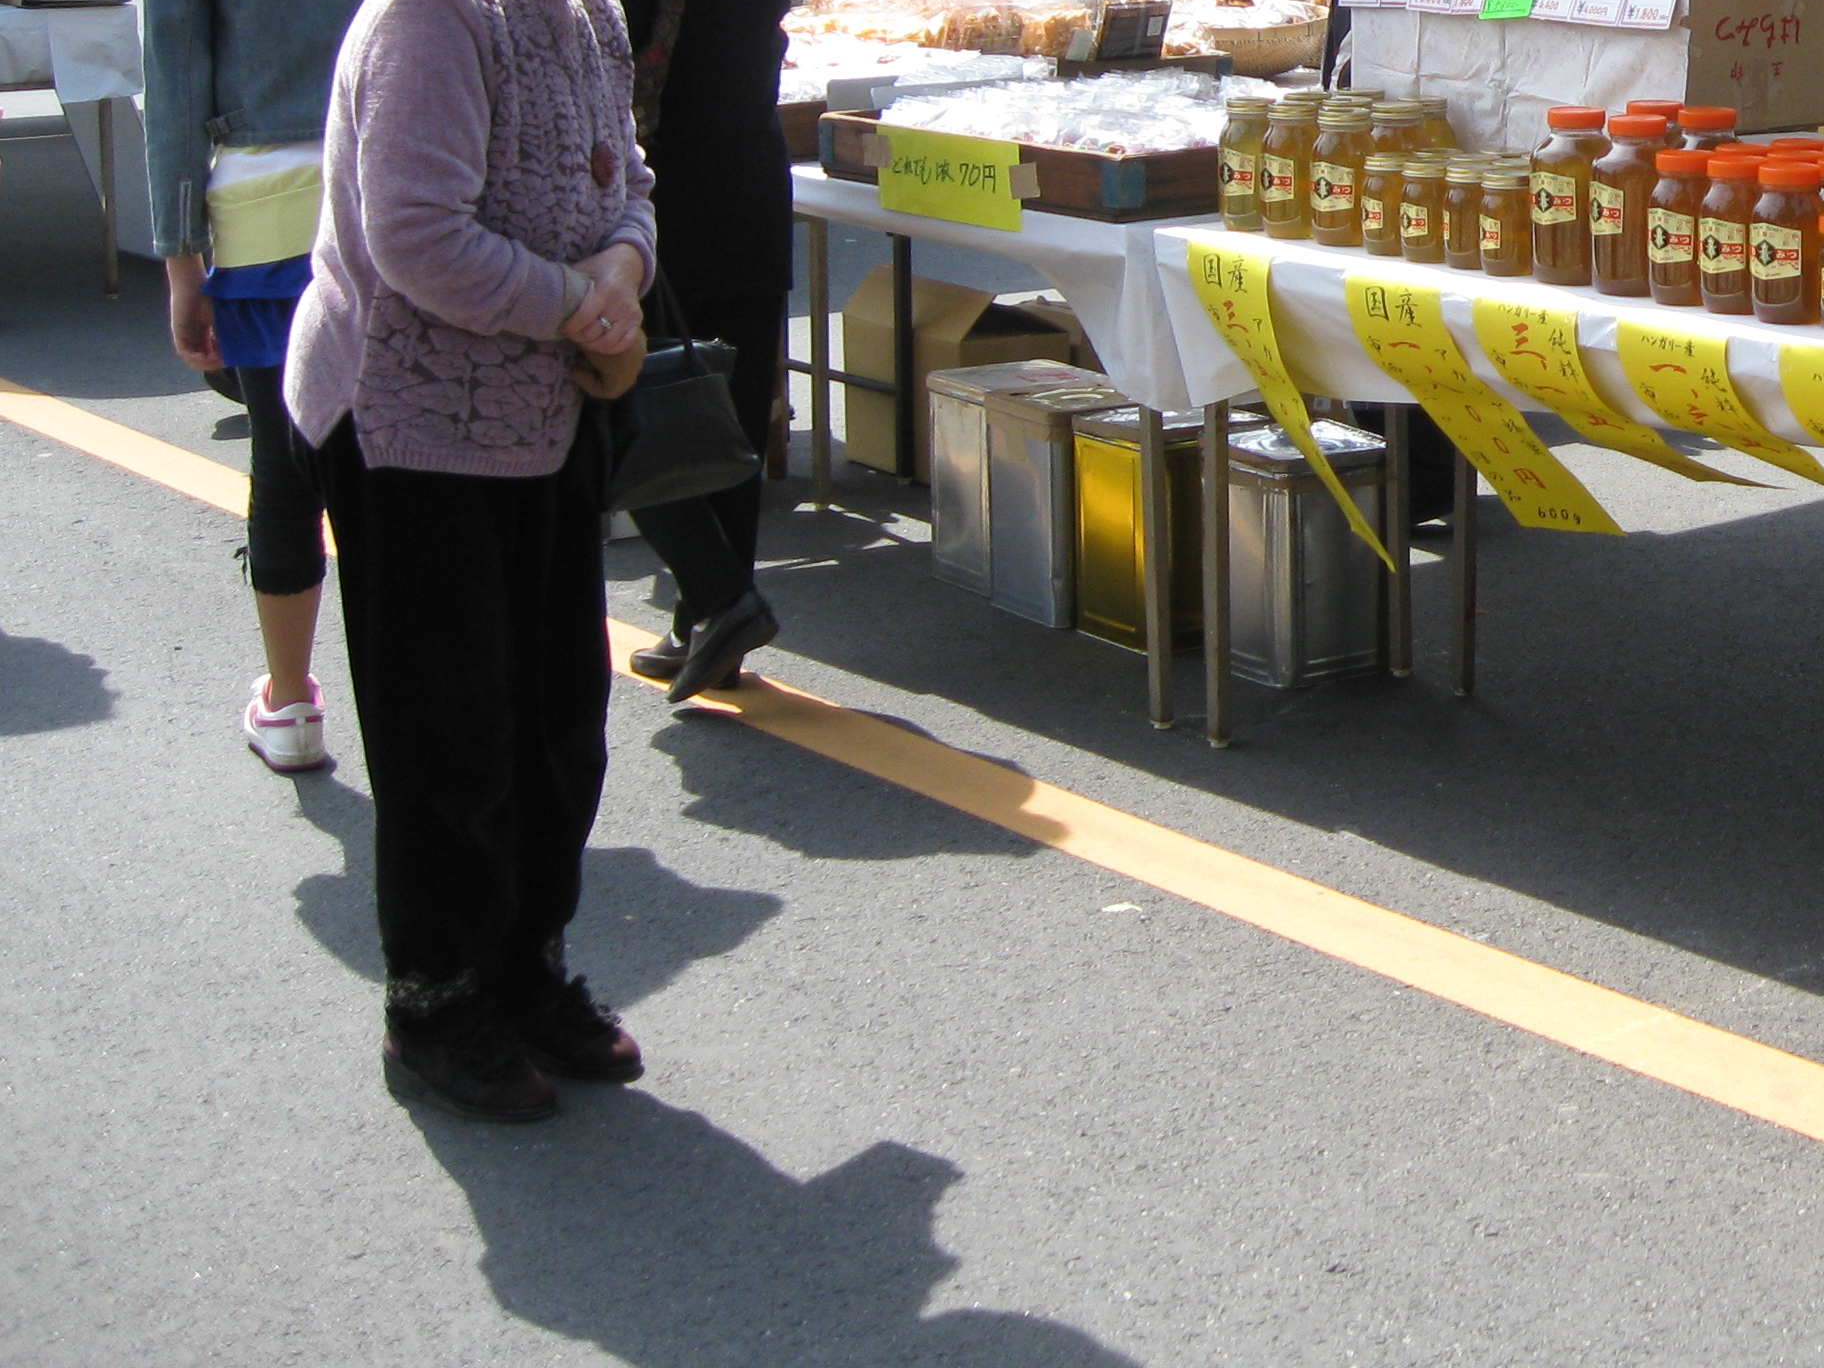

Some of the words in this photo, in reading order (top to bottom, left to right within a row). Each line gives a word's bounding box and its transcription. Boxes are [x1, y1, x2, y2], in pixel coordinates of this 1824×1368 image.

[1203, 253, 1249, 293] 国産
[1365, 285, 1422, 328] 国産
[1641, 335, 1695, 358] ハンガリー産
[1538, 507, 1581, 525] 600g
